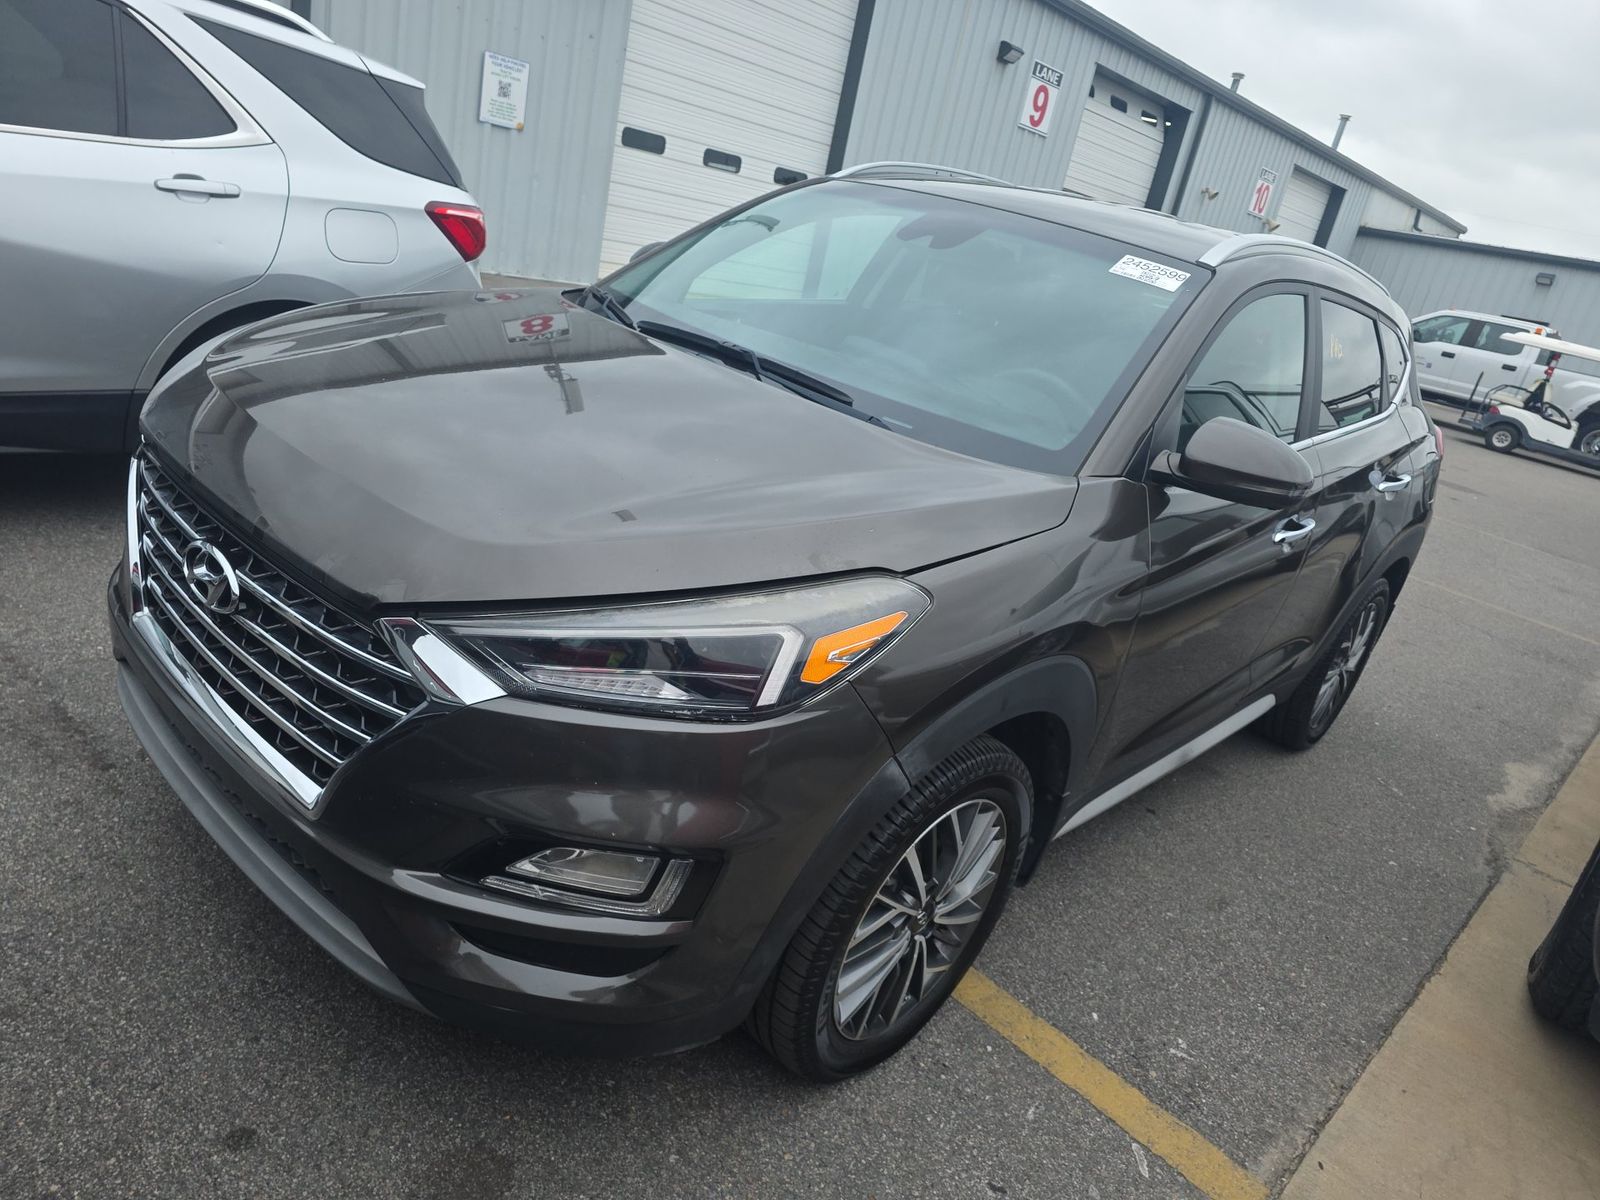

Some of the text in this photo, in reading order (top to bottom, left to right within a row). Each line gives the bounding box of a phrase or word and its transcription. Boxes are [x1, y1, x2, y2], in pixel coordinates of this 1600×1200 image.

[1035, 63, 1061, 86] LANE
[1029, 84, 1049, 127] 9
[1252, 182, 1270, 213] 10
[1122, 257, 1187, 282] 2452599
